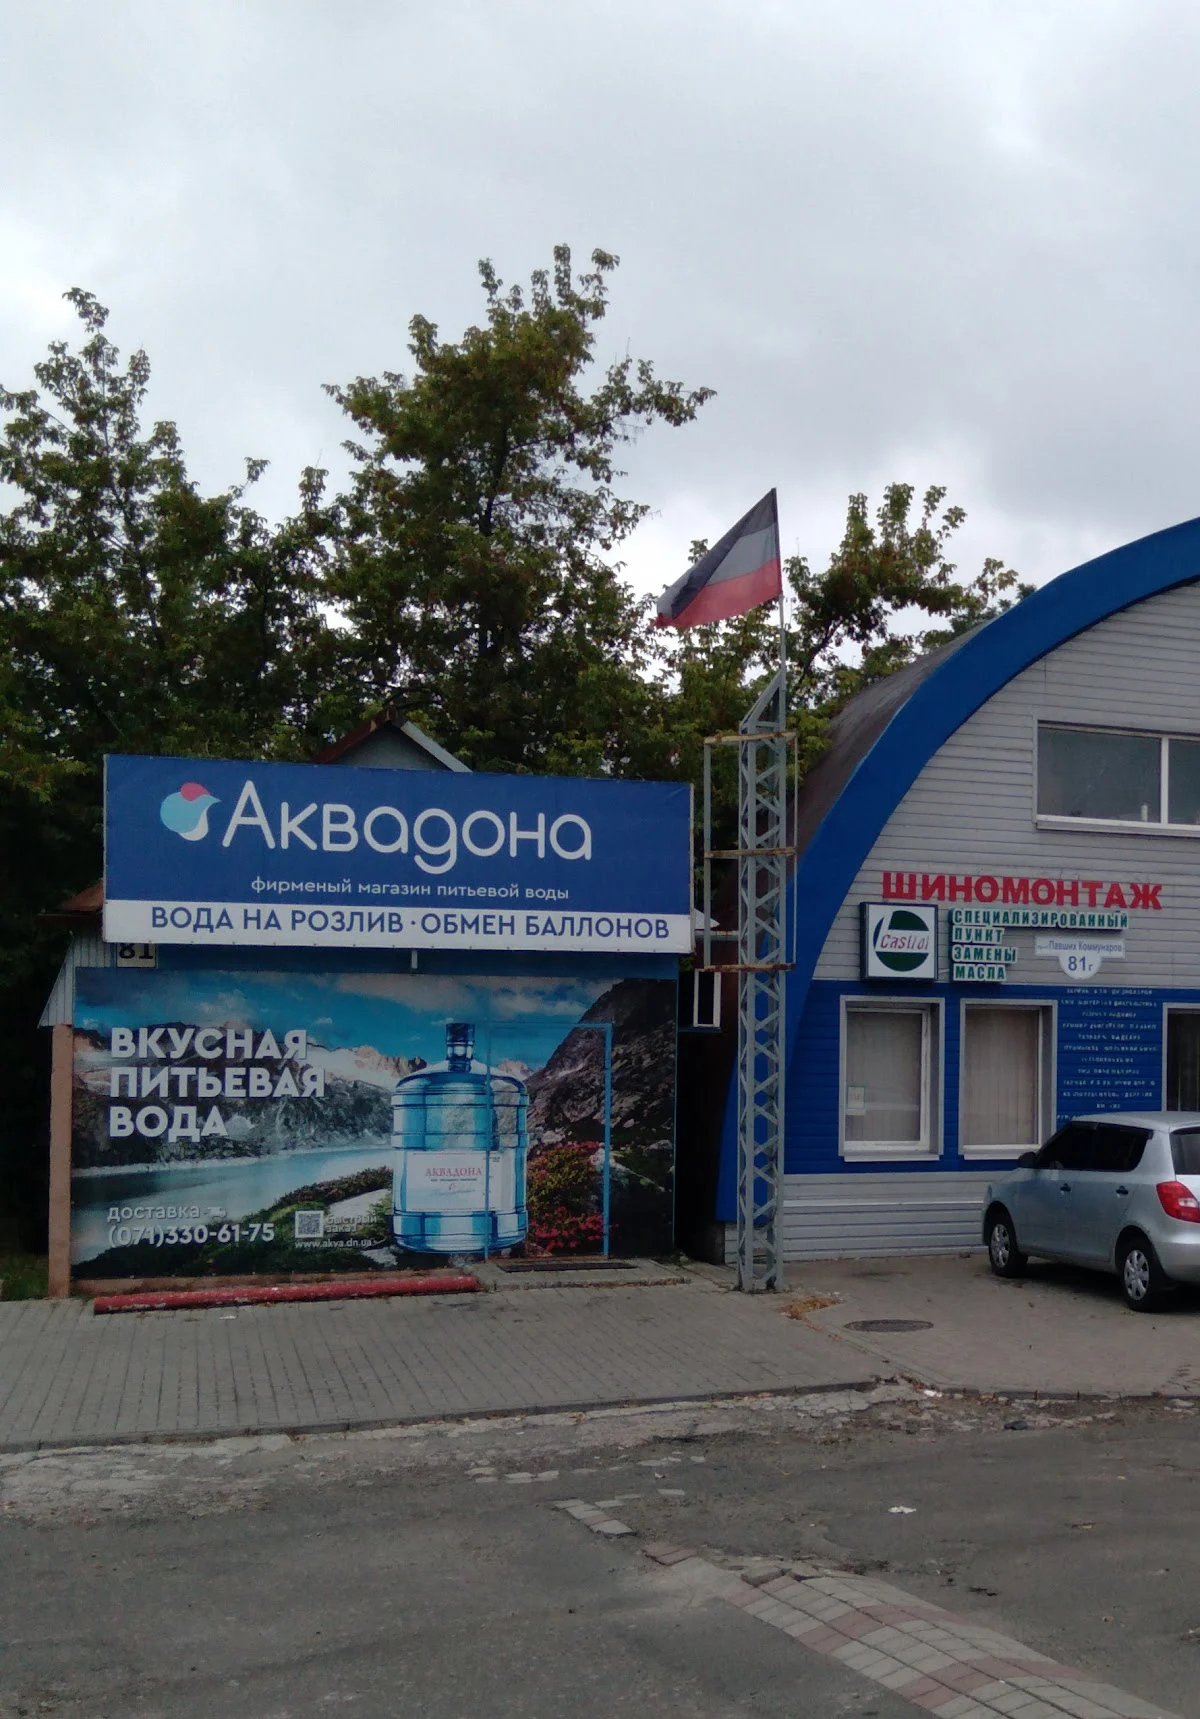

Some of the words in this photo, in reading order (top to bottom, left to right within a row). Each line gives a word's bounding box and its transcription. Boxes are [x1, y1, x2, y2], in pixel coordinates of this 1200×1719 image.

[222, 780, 592, 875] Аквадона
[251, 876, 352, 894] фирменый
[358, 884, 431, 896] магазин
[437, 884, 519, 898] питьевой
[525, 888, 569, 901] воды
[882, 870, 1163, 911] ШИНОМОНТАЖ
[152, 906, 234, 933] ВОДА
[243, 908, 282, 930] НА
[291, 909, 404, 933] РОЗЛИВ
[421, 912, 515, 936] ОБМЕН
[525, 915, 669, 939] БАЛЛОНОВ
[953, 908, 1128, 929] СПЕЦИАЛИЗИРОВАННЫЙ
[954, 927, 1004, 943] ПУНКТ
[953, 947, 1016, 963] ЗАМЕНЫ
[1048, 940, 1077, 951] Павших
[1078, 940, 1123, 954] Коммунаров
[955, 965, 1006, 981] МАСЛА
[111, 1027, 308, 1060] ВКУСНАЯ
[109, 1066, 325, 1099] ПИТЬЕВАЯ
[109, 1105, 229, 1143] ВОДА
[425, 1166, 483, 1178] АКВАДОНА
[106, 1205, 200, 1223] доставка
[326, 1212, 378, 1226] быстрый
[107, 1222, 276, 1248] (071)330-61-75
[325, 1224, 358, 1233] заказ
[294, 1237, 373, 1249] www.akva.dn.ua
